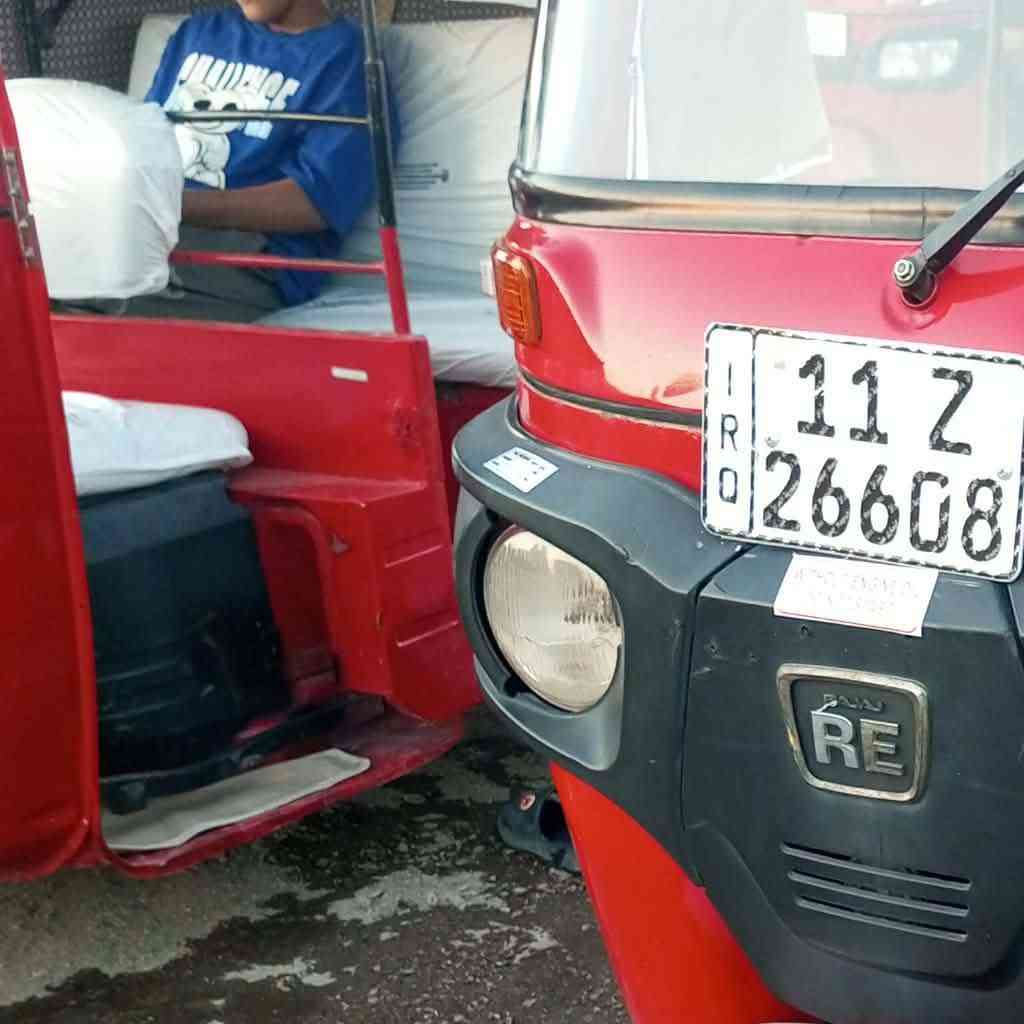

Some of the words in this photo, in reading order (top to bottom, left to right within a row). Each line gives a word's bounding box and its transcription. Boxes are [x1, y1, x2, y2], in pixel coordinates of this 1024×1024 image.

[797, 353, 889, 446] 11
[928, 366, 974, 457] Z
[762, 449, 1004, 563] 26608
[811, 710, 904, 776] RE
